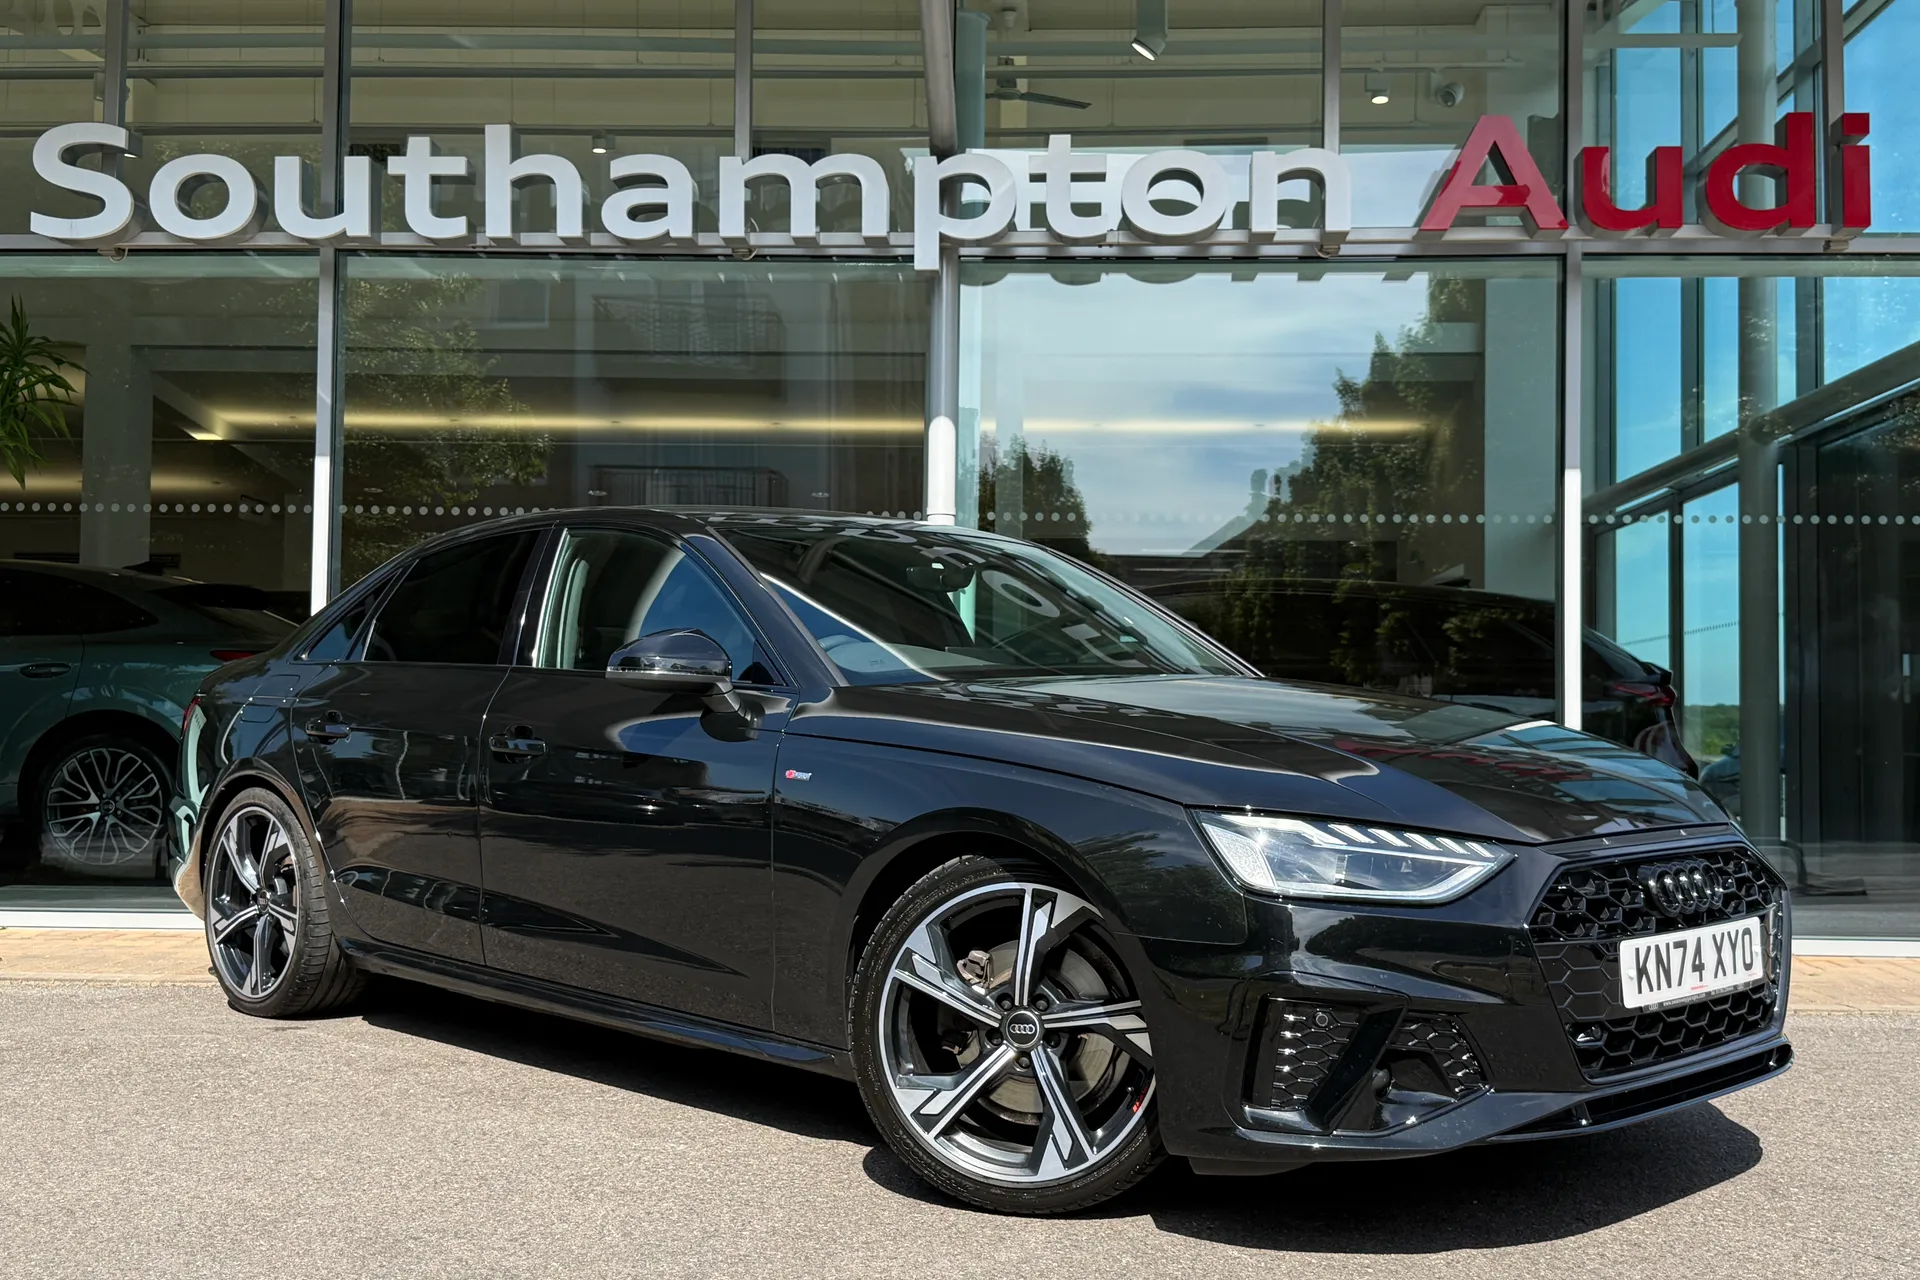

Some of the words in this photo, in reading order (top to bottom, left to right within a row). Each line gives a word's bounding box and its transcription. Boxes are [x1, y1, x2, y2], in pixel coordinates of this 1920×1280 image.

[30, 122, 1351, 270] Southampton
[1419, 111, 1871, 231] Audi
[1634, 936, 1705, 995] KN74
[1712, 927, 1754, 980] XYO
